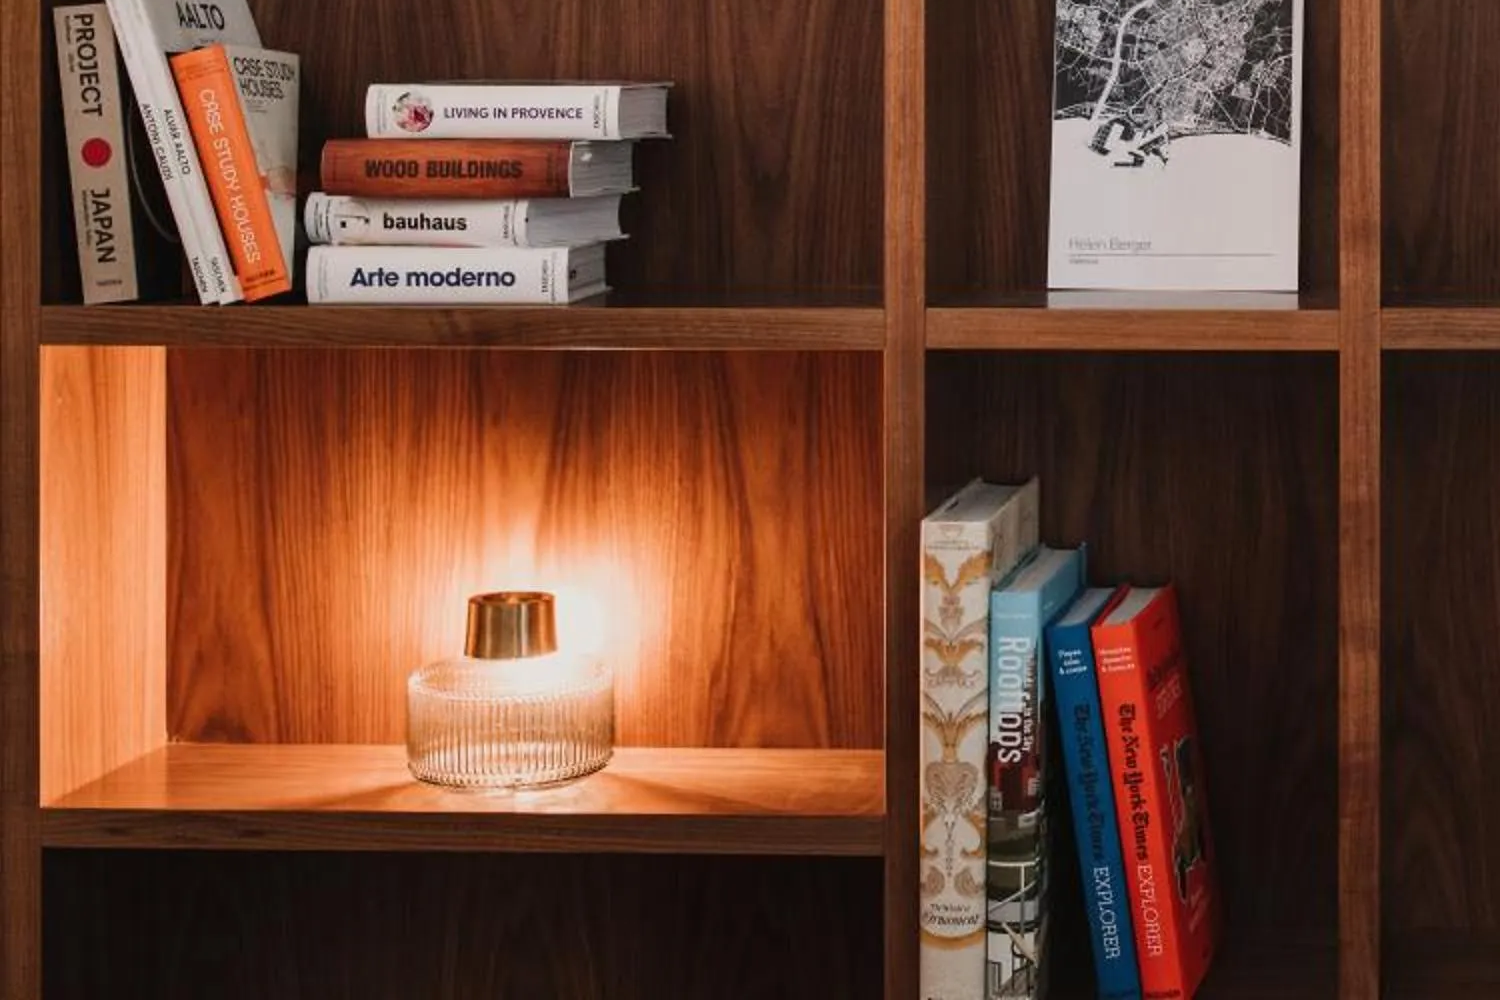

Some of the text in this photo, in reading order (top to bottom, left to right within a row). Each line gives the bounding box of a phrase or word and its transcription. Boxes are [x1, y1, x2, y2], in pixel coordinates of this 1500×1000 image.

[176, 0, 225, 31] AALTO
[233, 56, 264, 78] CASE
[238, 78, 285, 100] HOUSES
[141, 103, 160, 147] ANTONI
[443, 107, 583, 119] LIVING IN PROVENCE
[74, 13, 103, 117] PROJECT
[91, 188, 118, 263] JAPAN
[163, 108, 191, 176] ALVAR AALTO
[199, 89, 224, 136] CASE
[213, 137, 239, 195] STUDY
[231, 195, 262, 264] HOUSES
[365, 159, 523, 179] WOOD BUILDINGS
[383, 212, 467, 232] bauhaus
[350, 267, 516, 287] Arte moderno
[1118, 702, 1163, 957] The New York Times EXPLORER
[1093, 865, 1121, 959] EXPLORER
